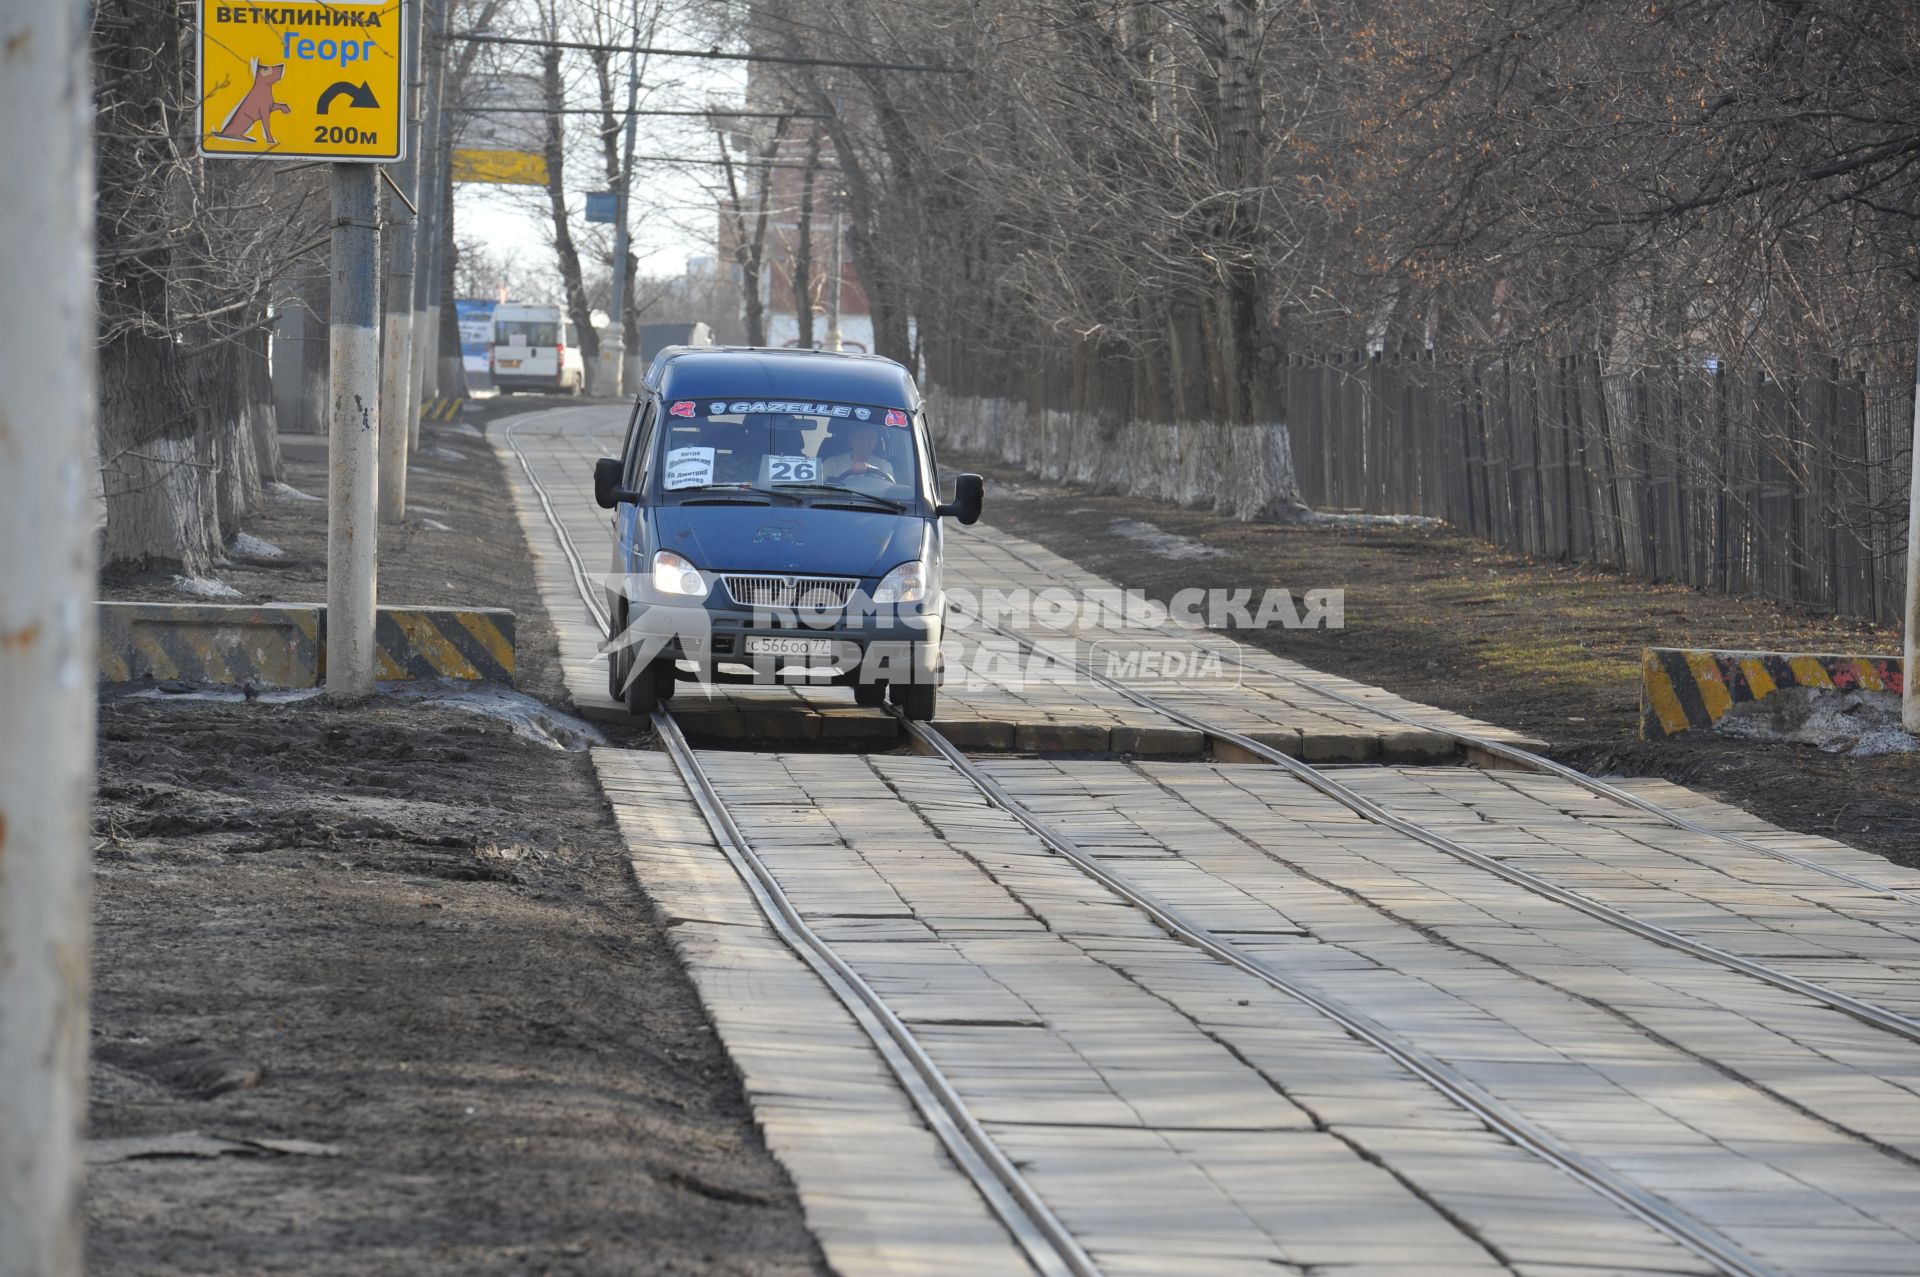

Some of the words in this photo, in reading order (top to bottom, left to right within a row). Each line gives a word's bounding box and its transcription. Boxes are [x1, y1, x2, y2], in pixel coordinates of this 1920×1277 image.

[216, 7, 382, 28] ВЕТКЛИНИКА
[283, 31, 376, 68] Георг
[314, 126, 378, 145] 200м
[728, 401, 852, 418] GAZELLE
[771, 462, 815, 480] 26
[812, 639, 827, 650] 77
